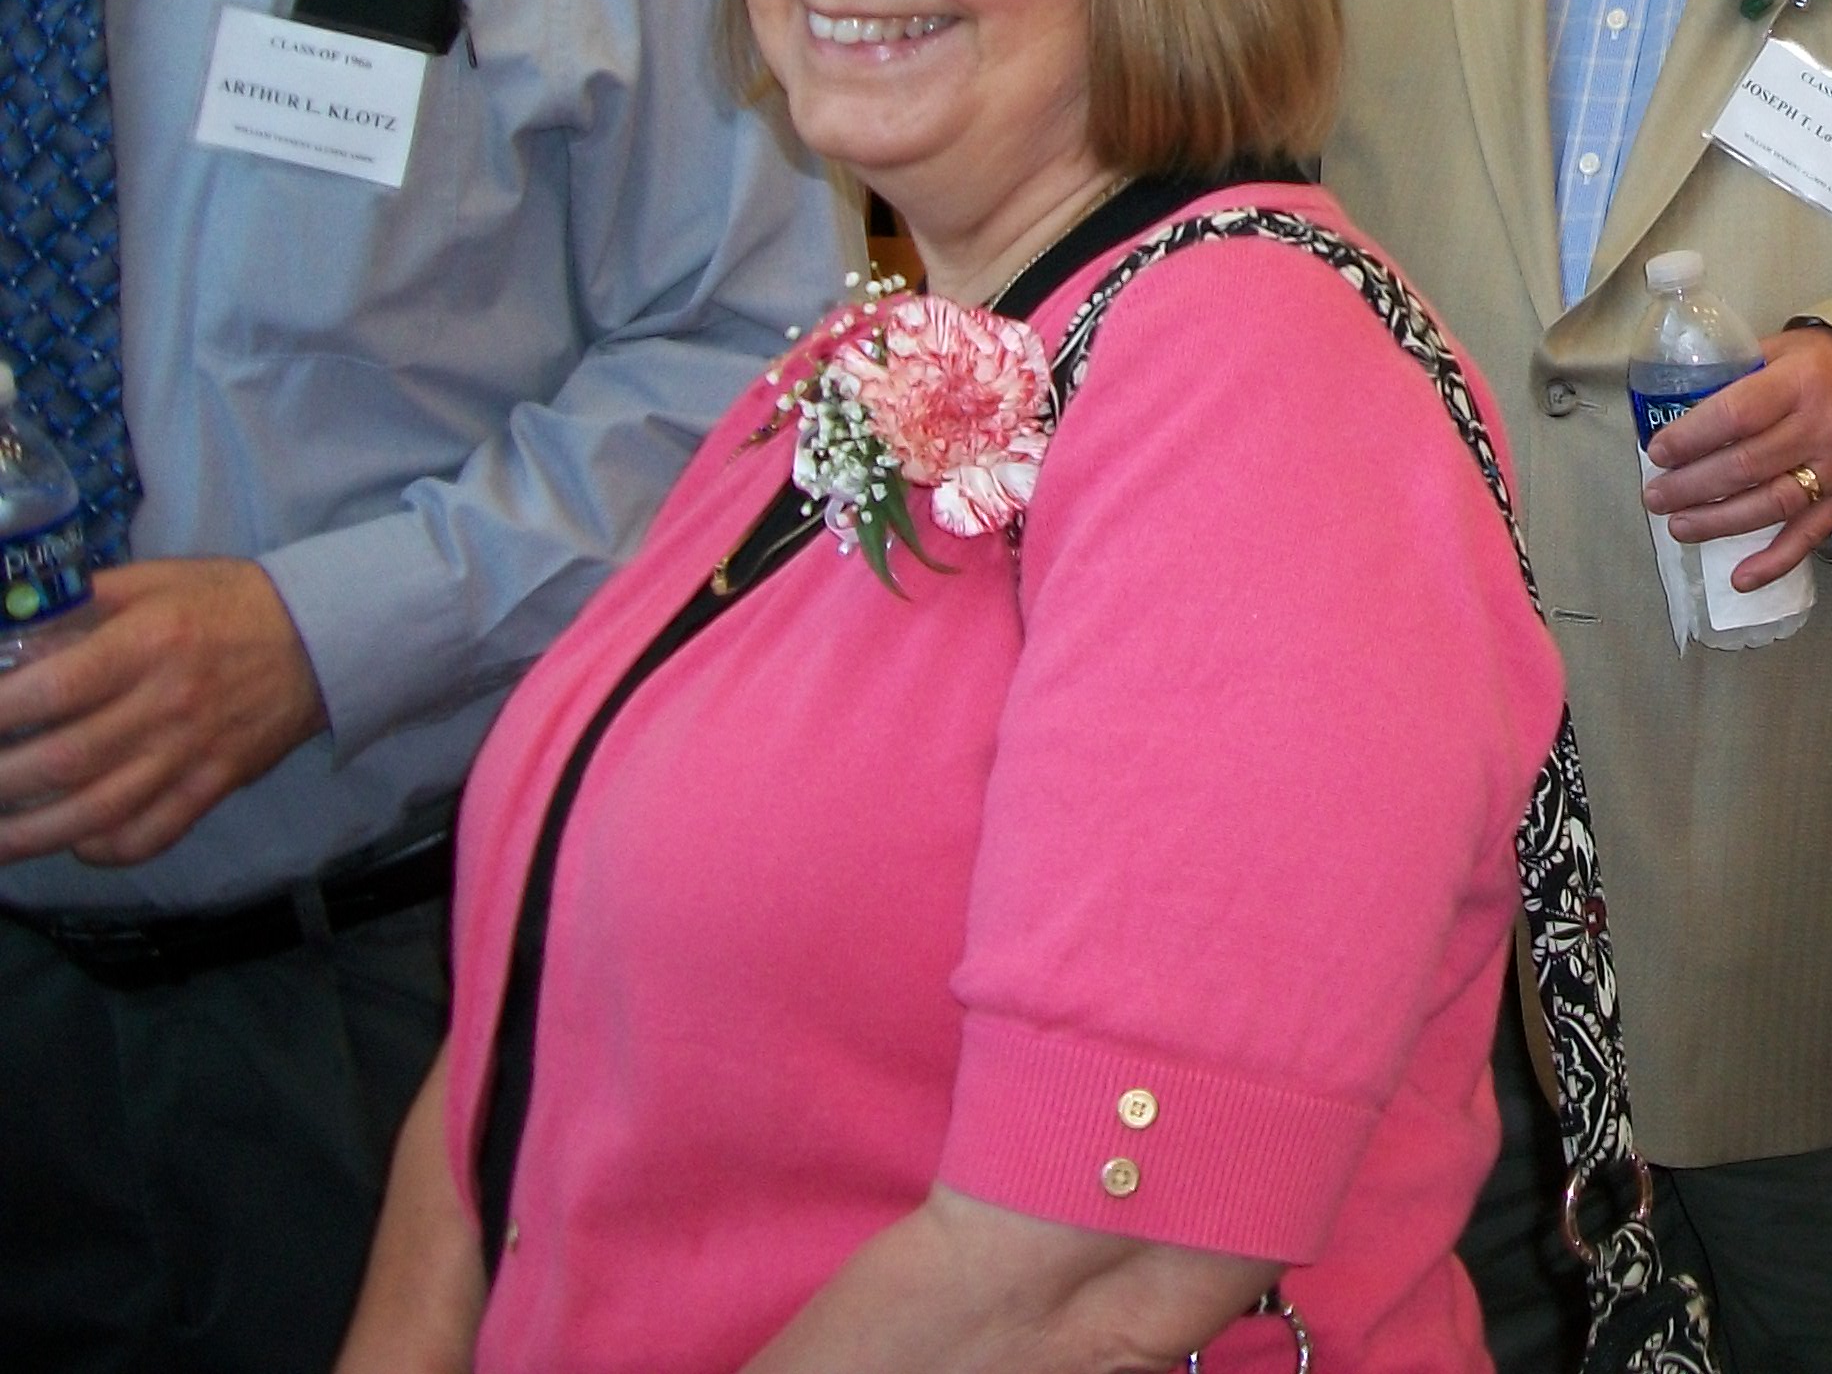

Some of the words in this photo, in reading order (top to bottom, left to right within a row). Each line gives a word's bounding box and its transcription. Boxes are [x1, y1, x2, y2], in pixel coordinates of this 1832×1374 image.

[270, 36, 314, 57] CLASS
[318, 48, 338, 63] OF
[220, 79, 300, 110] ARTHUR
[328, 105, 397, 133] KLOTZ
[1741, 79, 1799, 121] JOSEPH
[1800, 114, 1813, 132] T.
